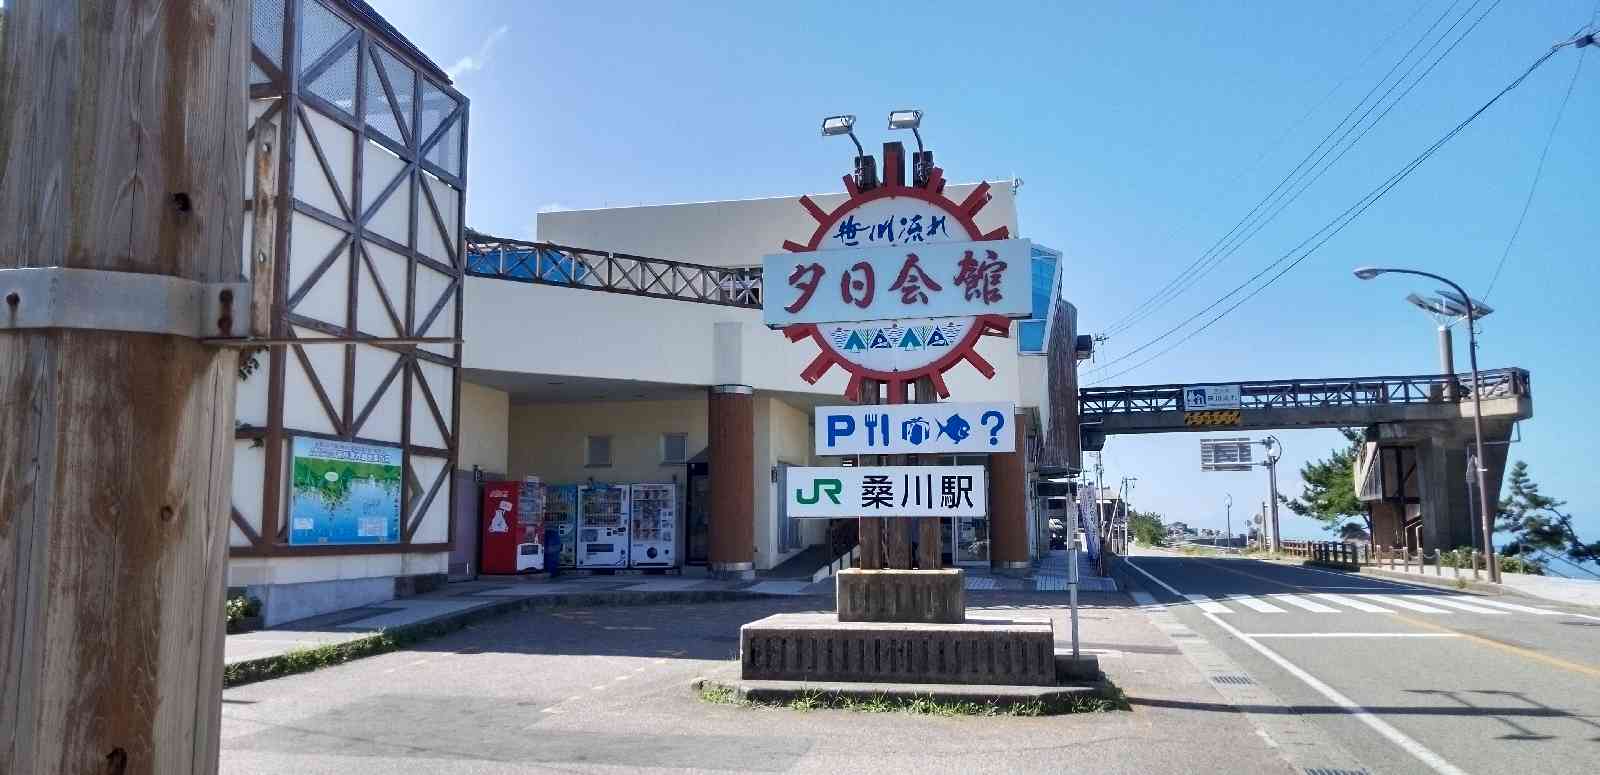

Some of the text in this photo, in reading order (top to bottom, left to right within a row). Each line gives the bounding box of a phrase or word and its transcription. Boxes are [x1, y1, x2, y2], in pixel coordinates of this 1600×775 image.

[783, 250, 1007, 314] 夕日会館
[827, 415, 856, 447] P
[796, 474, 974, 510] JR 桑川駅
